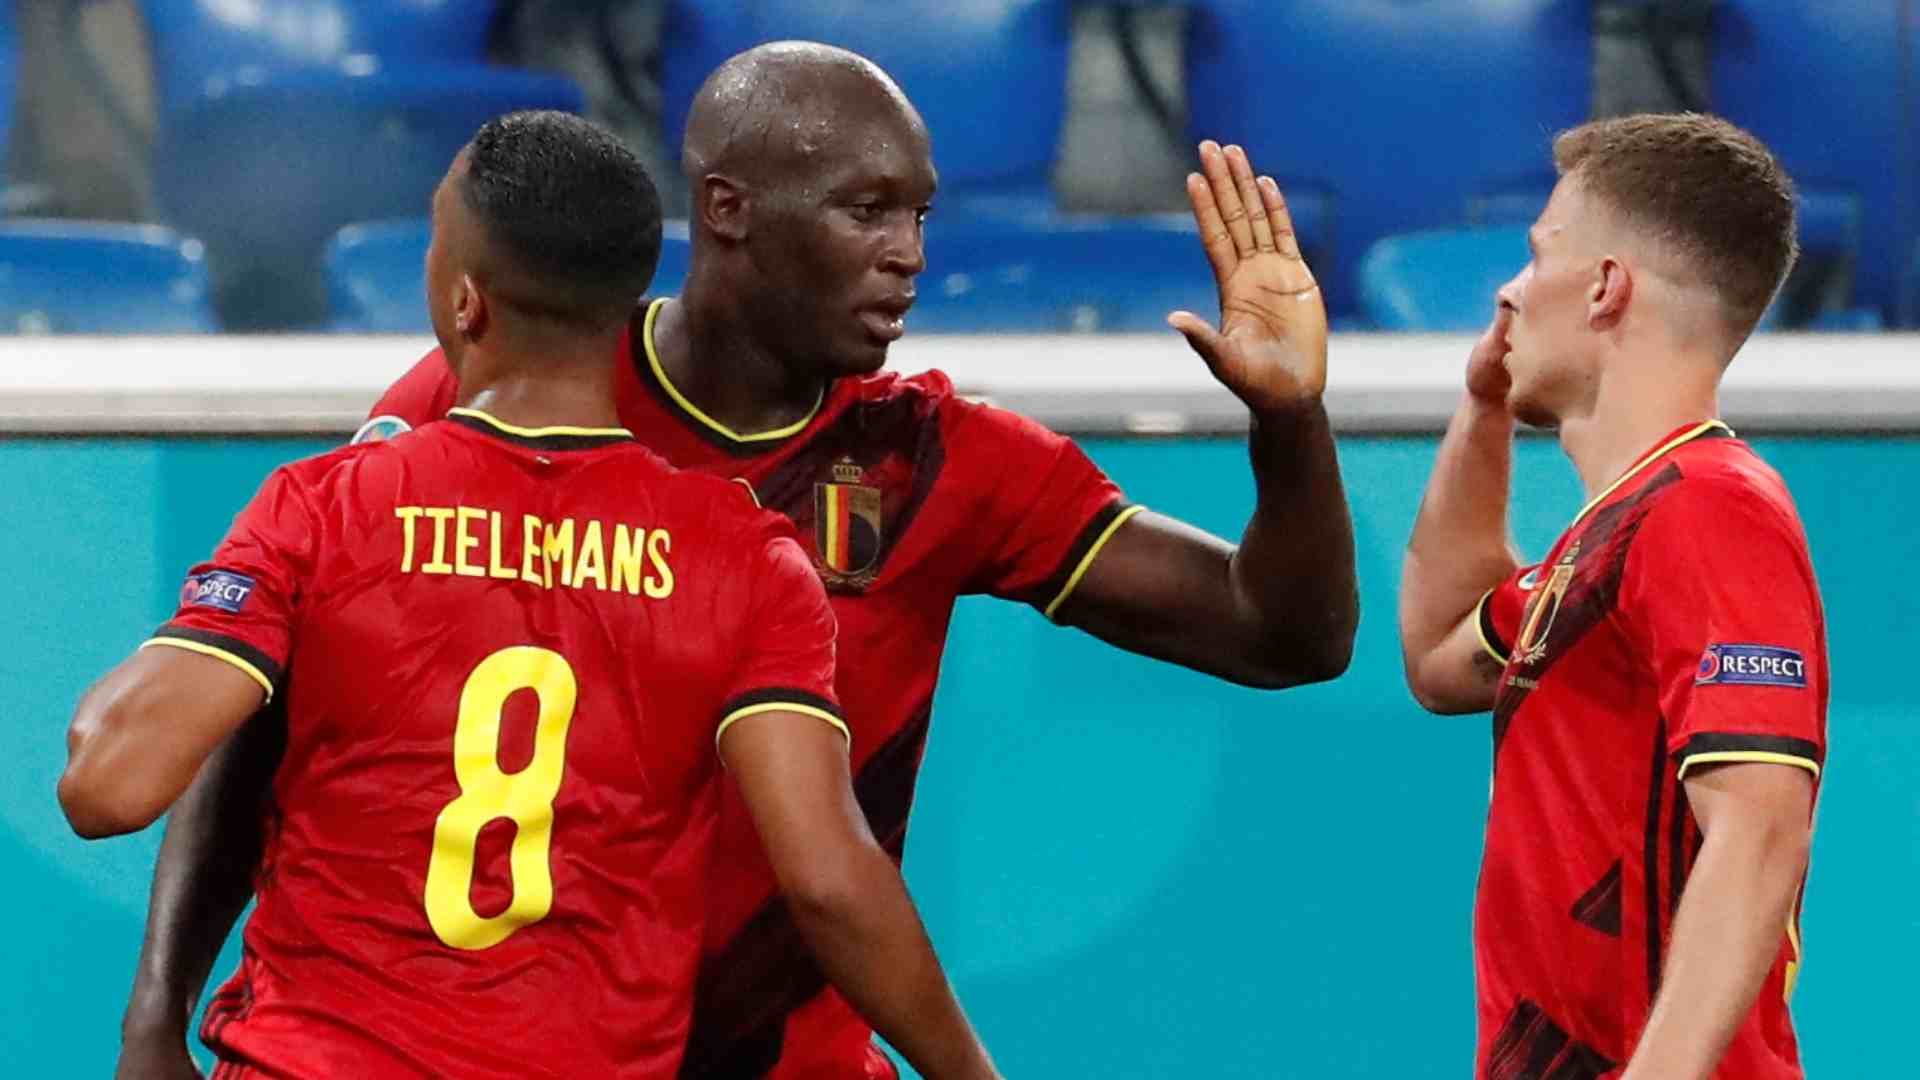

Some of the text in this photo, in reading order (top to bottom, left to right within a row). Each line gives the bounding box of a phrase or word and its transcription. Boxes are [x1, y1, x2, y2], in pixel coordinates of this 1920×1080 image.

[395, 506, 674, 599] TIELEMANS
[1723, 655, 1804, 677] RESPECT
[424, 645, 577, 950] 8
